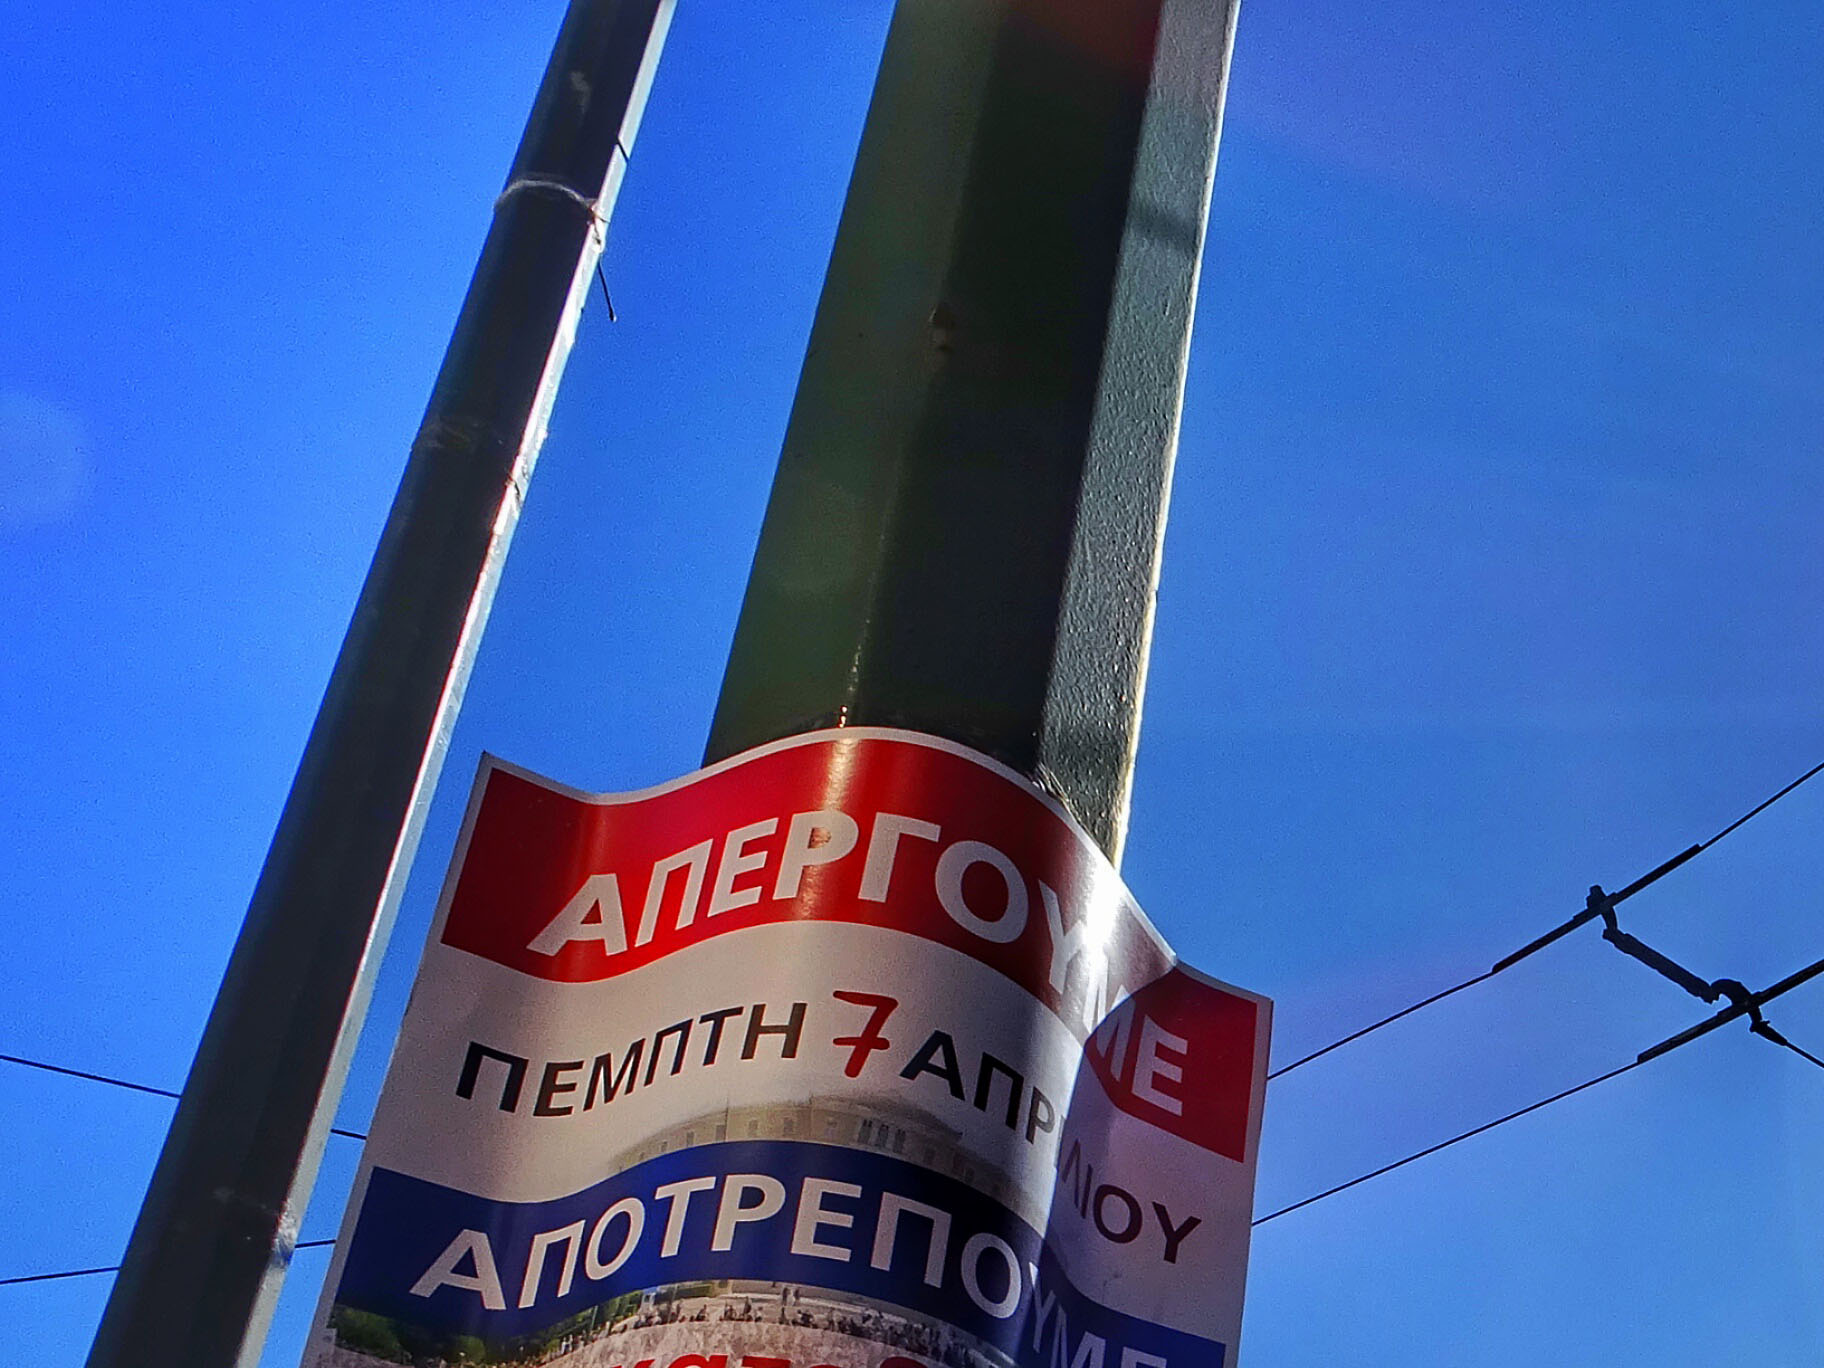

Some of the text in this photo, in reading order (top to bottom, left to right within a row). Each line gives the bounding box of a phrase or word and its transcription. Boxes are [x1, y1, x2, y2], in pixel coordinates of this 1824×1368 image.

[456, 1002, 807, 1117] ΠΕΜΠΤΗ
[832, 991, 899, 1078] 7
[527, 812, 1191, 1115] ΑΠΕΡΓΟΥΜΕ
